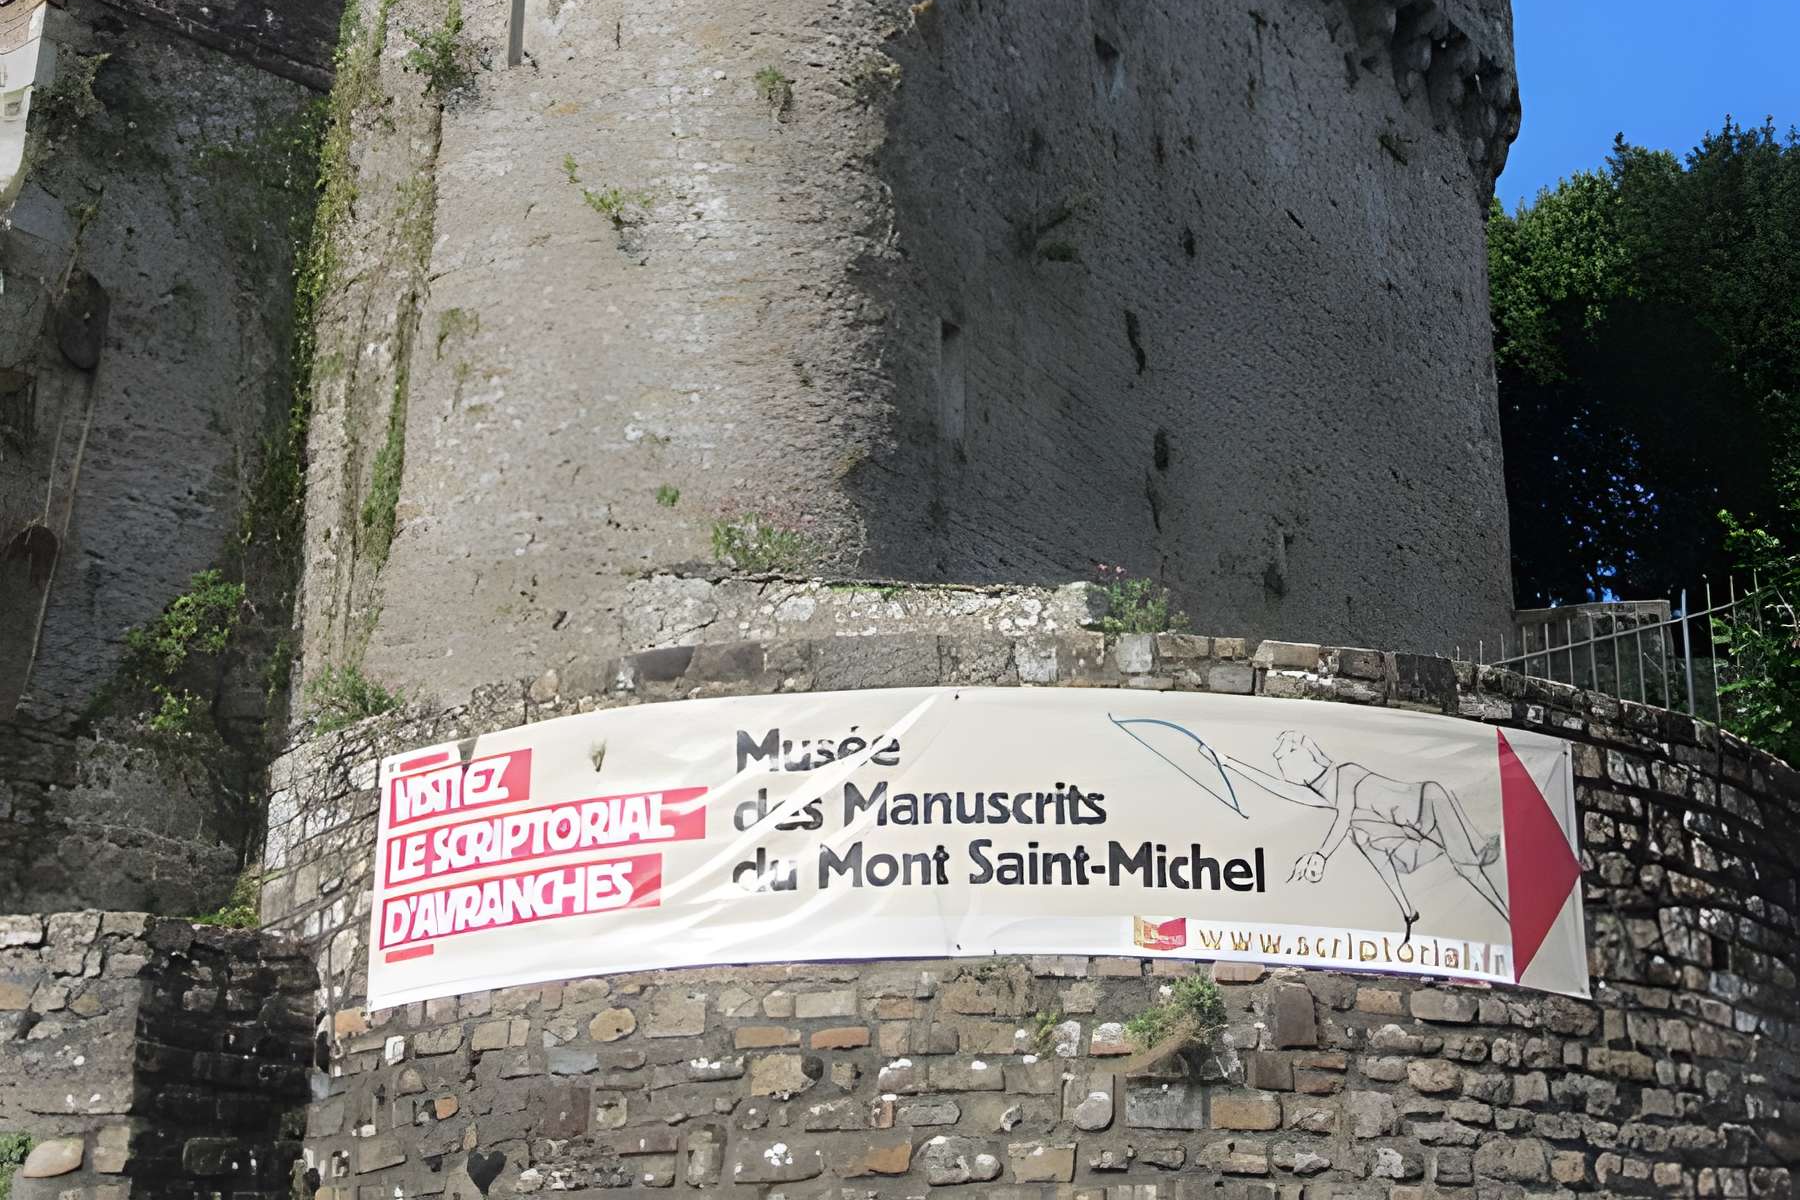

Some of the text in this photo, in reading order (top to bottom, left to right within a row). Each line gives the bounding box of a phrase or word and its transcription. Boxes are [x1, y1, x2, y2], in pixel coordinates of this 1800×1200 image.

[736, 725, 901, 775] Musée
[395, 755, 512, 823] VISITEZ
[734, 781, 1108, 832] des Manuscrits
[388, 793, 676, 884] LE SCRIPTORIAL
[733, 838, 1266, 893] du Mont Saint-Michel
[383, 861, 634, 947] D'AVRANCHES
